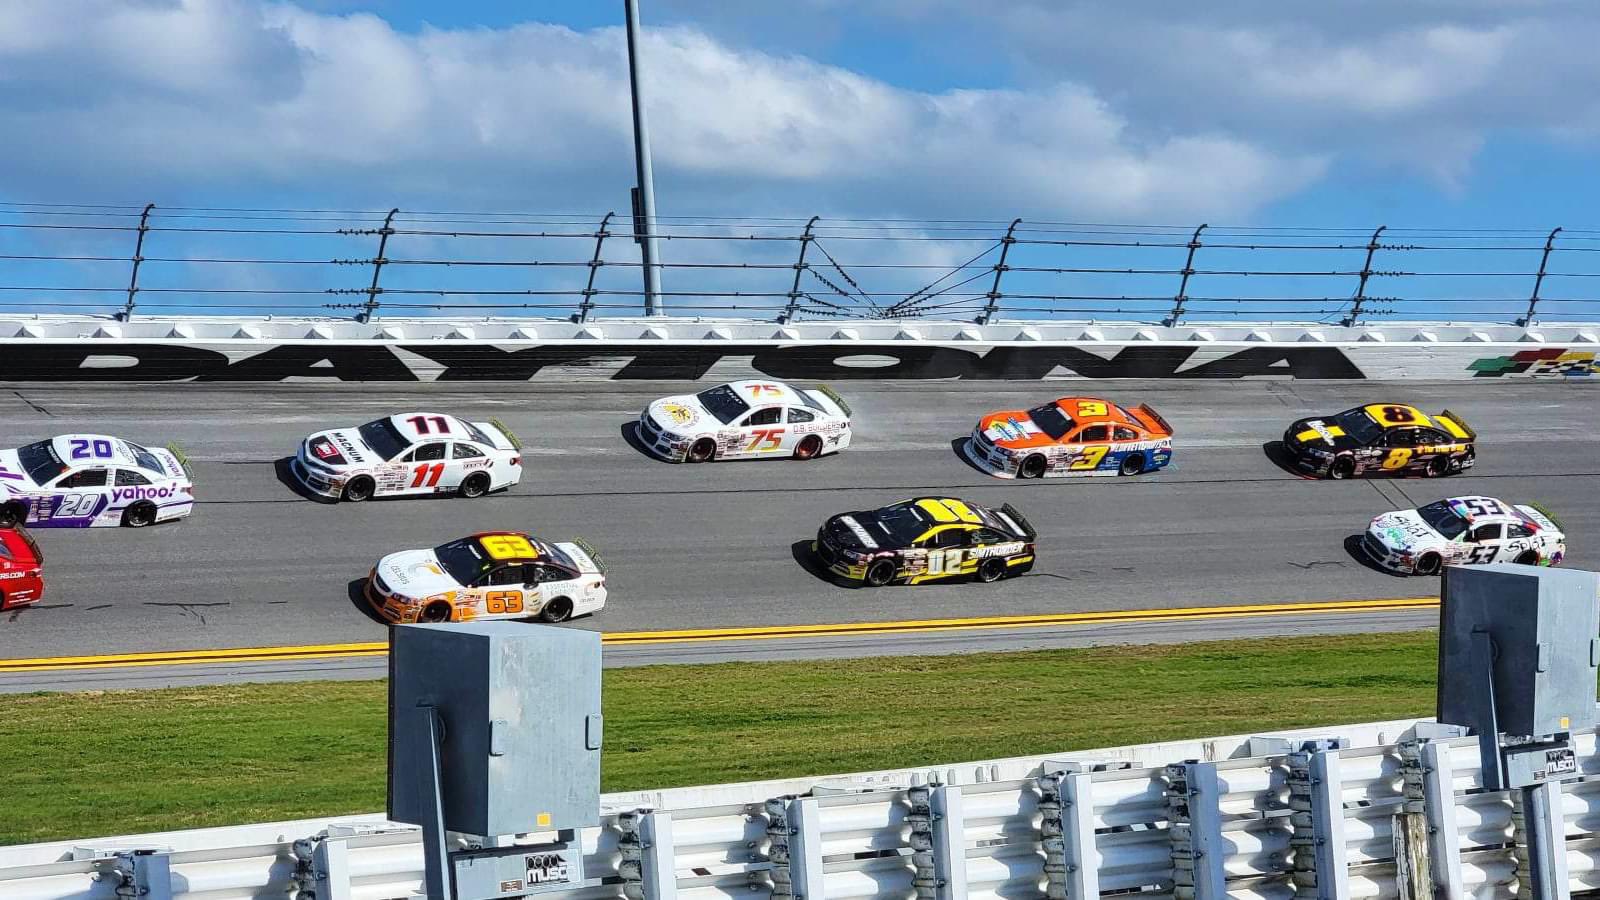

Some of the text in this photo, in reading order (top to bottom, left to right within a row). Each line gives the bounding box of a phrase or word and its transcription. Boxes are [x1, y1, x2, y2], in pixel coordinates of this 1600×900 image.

[0, 344, 1366, 382] DAYTONA
[745, 383, 784, 399] 75
[1383, 406, 1416, 422] 8
[407, 416, 450, 435] 11
[70, 439, 113, 459] 20
[331, 432, 365, 463] MAGNUM
[745, 429, 785, 450] 75
[1070, 446, 1111, 471] 3
[1382, 448, 1412, 469] 8
[410, 463, 445, 488] 11
[111, 482, 177, 503] yahoo!
[55, 494, 99, 517] 20
[1463, 499, 1505, 516] 53
[1463, 546, 1500, 565] 53
[485, 590, 524, 614] 63
